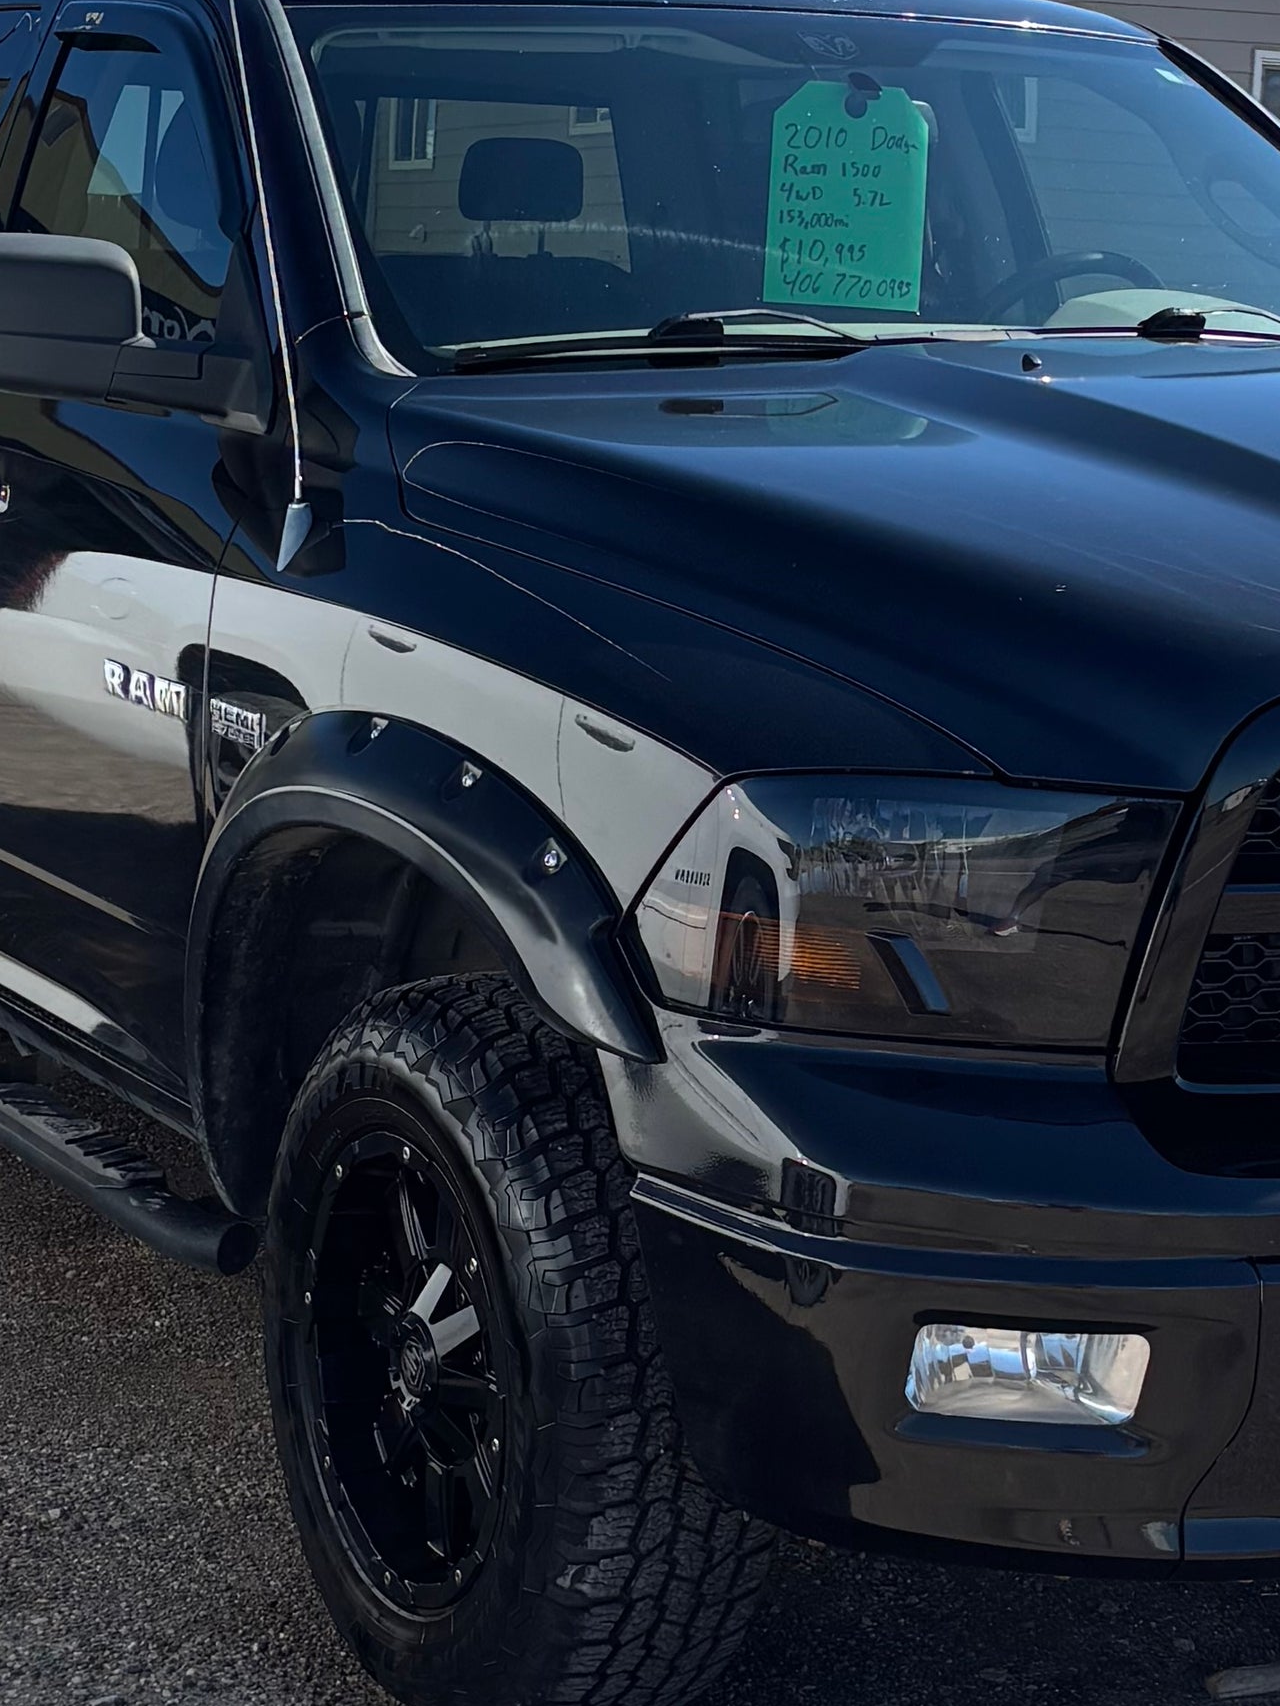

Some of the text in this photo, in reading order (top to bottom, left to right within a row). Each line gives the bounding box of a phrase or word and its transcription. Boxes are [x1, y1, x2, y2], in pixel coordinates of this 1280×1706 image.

[784, 123, 848, 149] 2010
[783, 154, 882, 178] Ram 1500
[852, 188, 892, 207] 5.7L
[779, 237, 867, 273] $10,995
[783, 271, 912, 299] 406 770 0995
[104, 658, 190, 723] RAM
